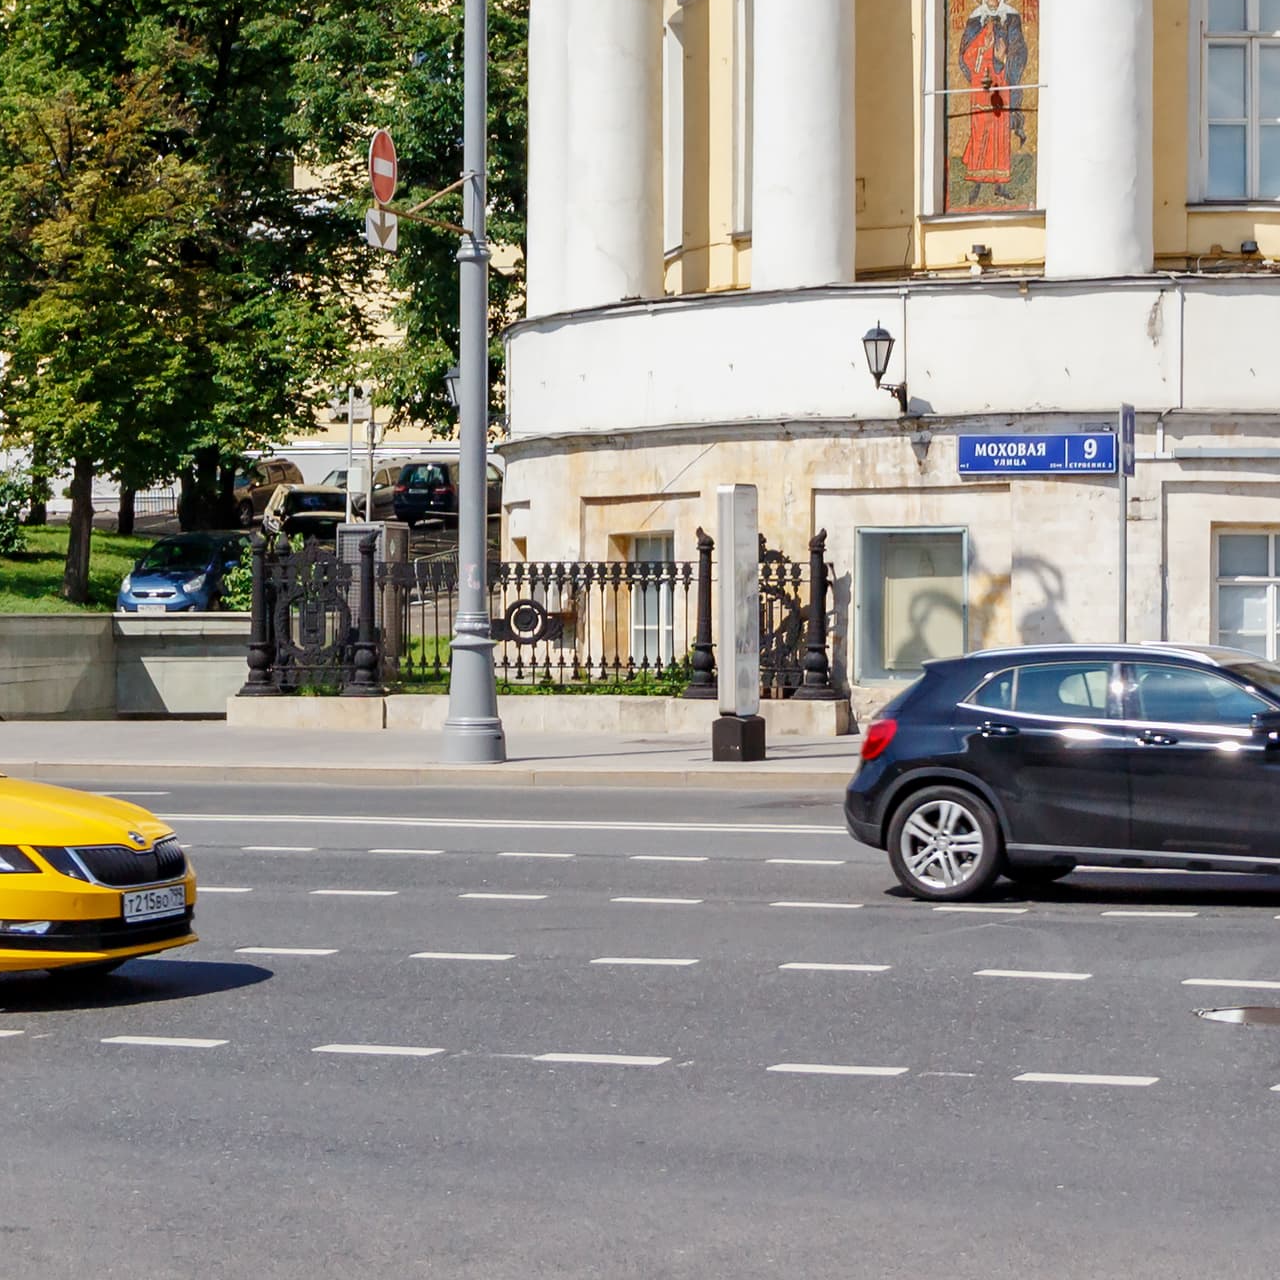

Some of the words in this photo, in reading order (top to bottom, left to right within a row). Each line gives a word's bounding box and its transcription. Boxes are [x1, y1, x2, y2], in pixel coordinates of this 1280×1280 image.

[975, 442, 1047, 457] МОХОВАЯ
[1083, 438, 1098, 460] 9
[993, 458, 1027, 467] УЛИЦА
